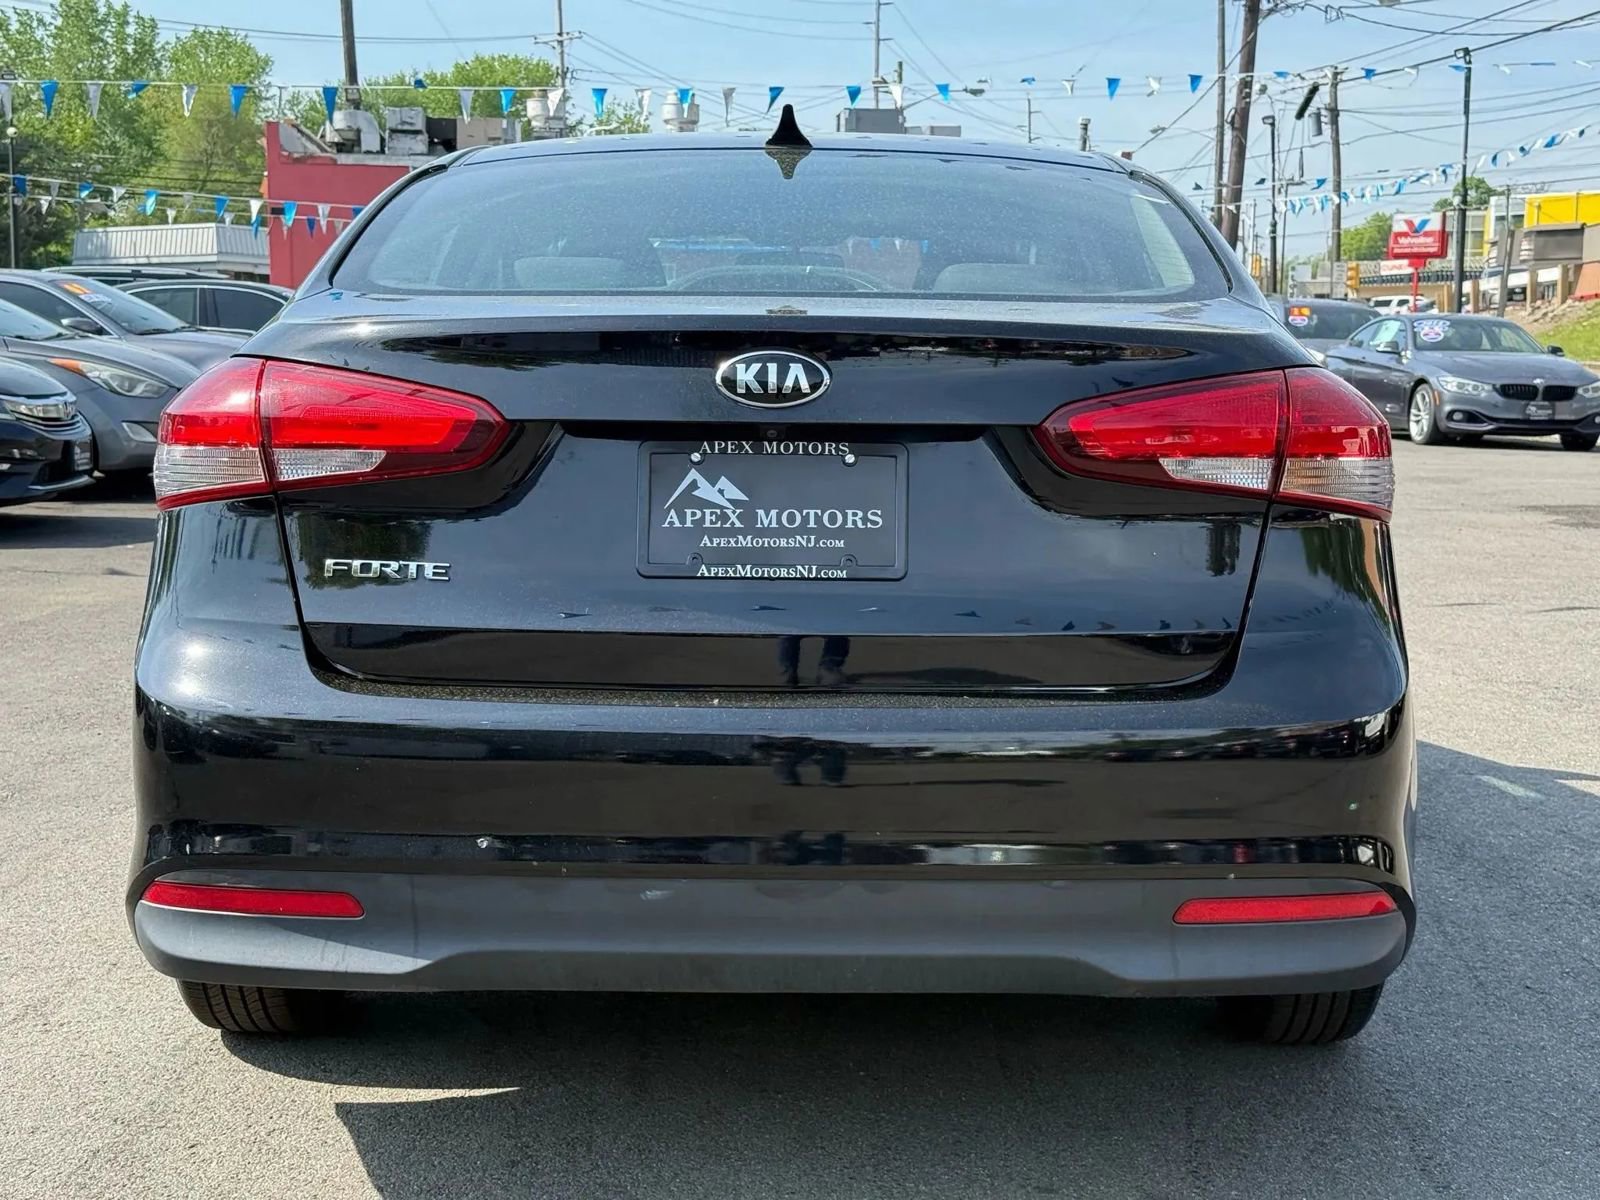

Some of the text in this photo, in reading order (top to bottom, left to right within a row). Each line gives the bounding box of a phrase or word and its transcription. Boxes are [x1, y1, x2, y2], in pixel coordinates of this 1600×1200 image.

[735, 362, 811, 394] KIA
[699, 440, 850, 456] APEX MOTORS
[661, 508, 883, 529] APEX MOTORS
[324, 558, 450, 580] FORTE
